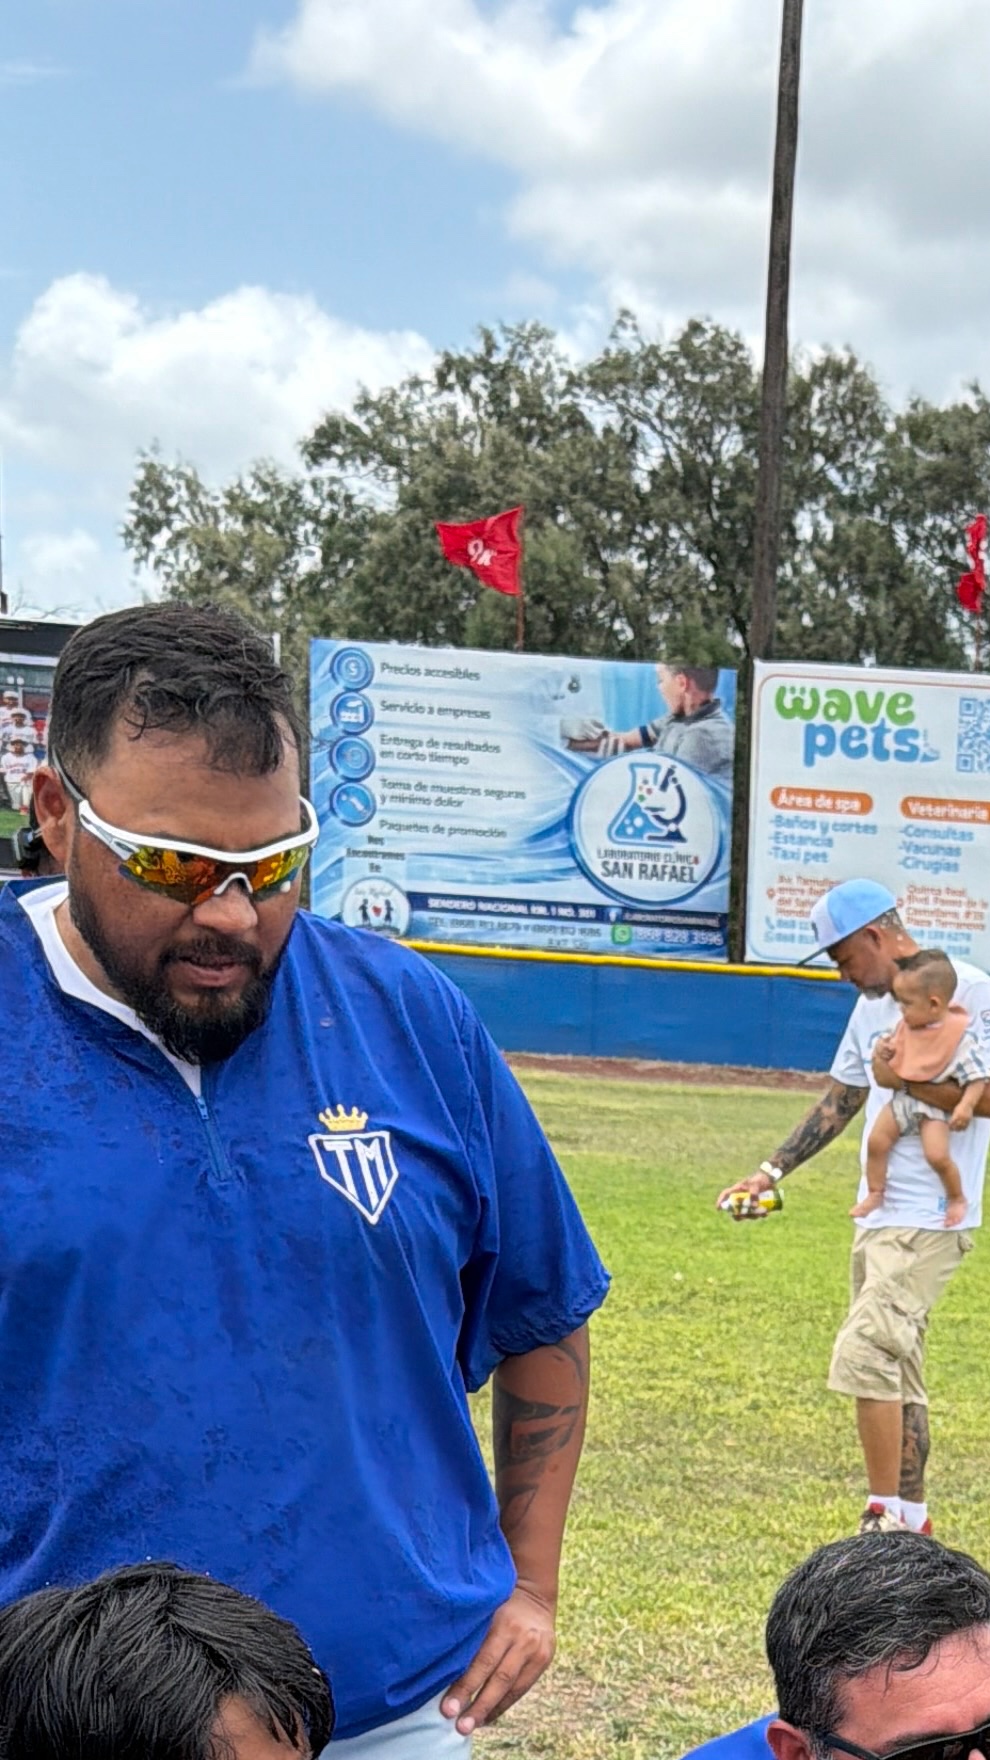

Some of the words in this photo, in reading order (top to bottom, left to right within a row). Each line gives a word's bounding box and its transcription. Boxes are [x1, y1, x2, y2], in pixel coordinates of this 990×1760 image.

[380, 662, 421, 676] Precios
[424, 667, 480, 681] accesibles
[380, 701, 424, 714] Servicio
[427, 706, 434, 715] a
[437, 707, 491, 719] empresas
[774, 685, 916, 726] wave
[380, 735, 423, 750] Entrega
[426, 737, 440, 748] de
[442, 739, 501, 753] resultados
[804, 717, 919, 767] pets
[380, 750, 396, 759] en
[398, 751, 426, 762] corto
[429, 752, 469, 766] tiempo
[380, 778, 412, 791] Toma
[414, 781, 428, 792] de
[430, 783, 481, 796] muestras
[484, 787, 526, 801] seguras
[434, 796, 464, 808] dolor
[777, 789, 812, 807] Área
[816, 793, 834, 809] de
[835, 797, 862, 812] spa
[908, 801, 989, 822] Veterinaria
[380, 820, 428, 836] Paquetes
[432, 824, 445, 834] de
[819, 820, 829, 835] y
[832, 822, 878, 835] cortes
[804, 850, 828, 865] pet
[600, 861, 634, 880] SAN
[638, 864, 698, 884] RAFAEL
[324, 1136, 389, 1210] TM
